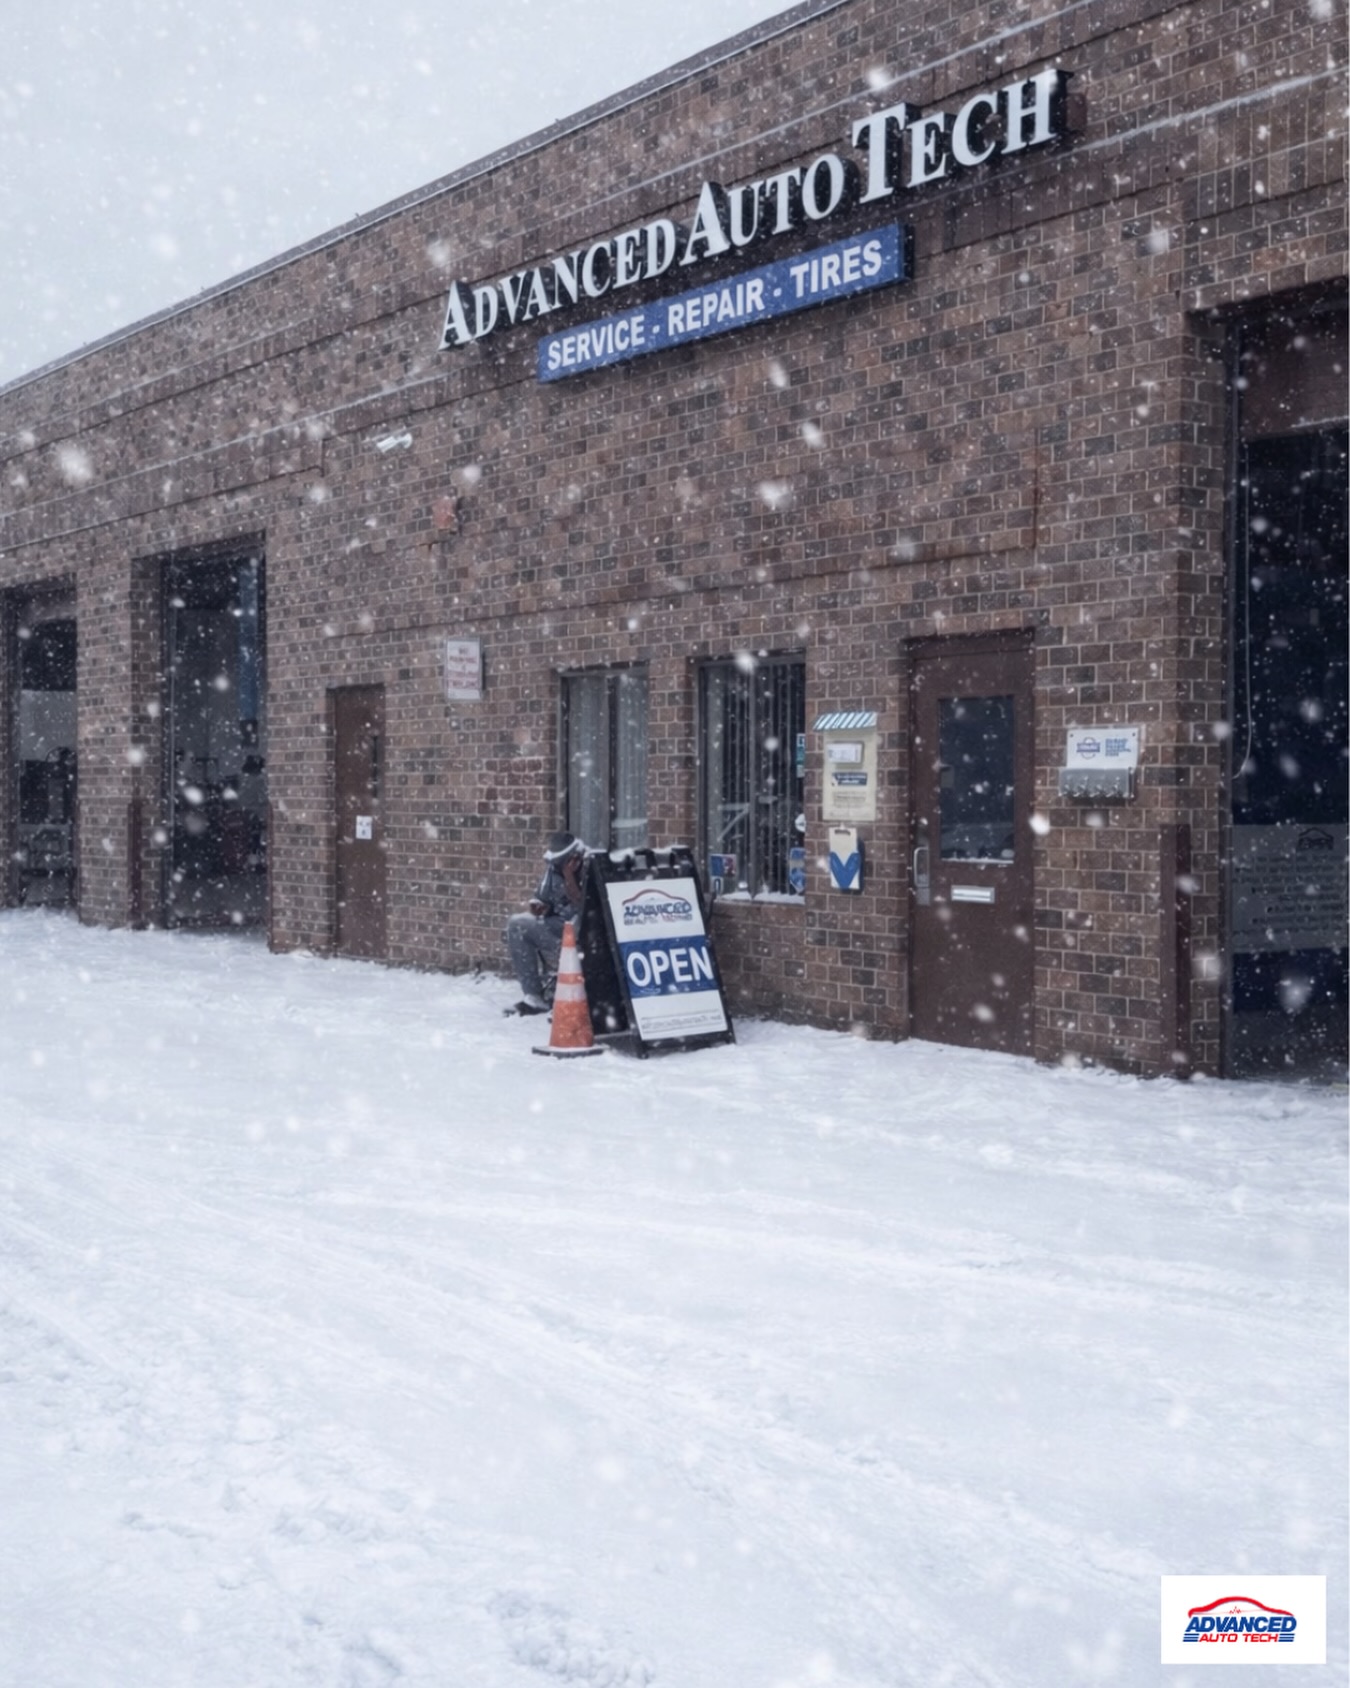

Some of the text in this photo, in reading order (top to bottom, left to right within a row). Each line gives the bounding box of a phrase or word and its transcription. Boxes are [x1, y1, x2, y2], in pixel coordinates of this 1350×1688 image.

[438, 68, 1058, 350] ADVANCED AUTO TECH
[547, 239, 883, 371] SERVICE REPAIR TIRES
[626, 945, 715, 987] OPEN
